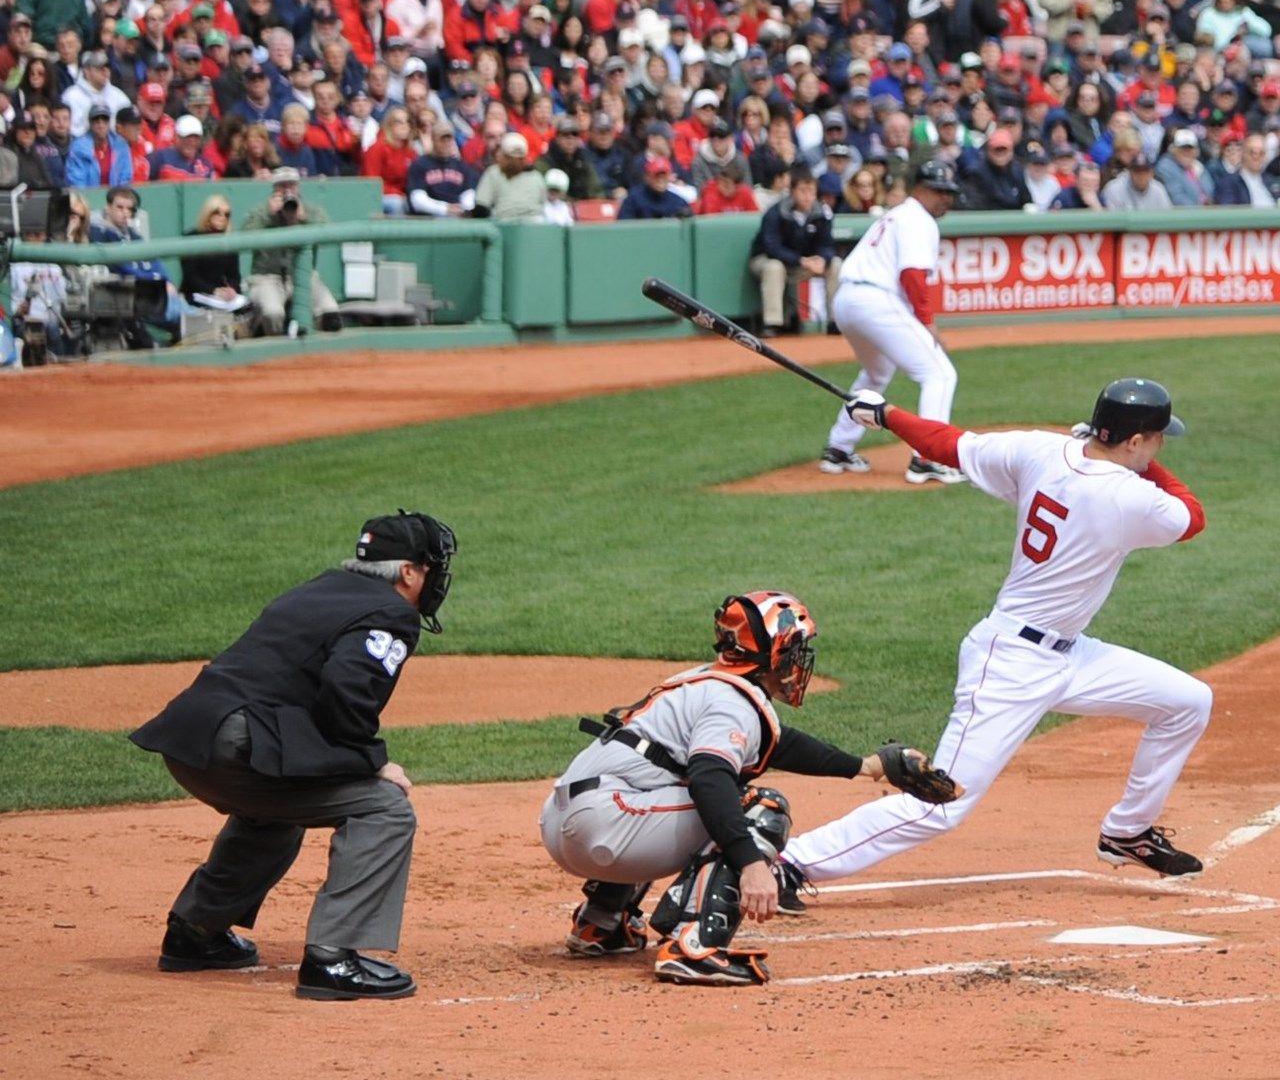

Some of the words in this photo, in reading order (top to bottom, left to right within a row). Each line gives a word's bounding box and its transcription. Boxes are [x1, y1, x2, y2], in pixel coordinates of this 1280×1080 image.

[927, 237, 1010, 286] RED
[1020, 234, 1106, 282] SOX
[1021, 490, 1069, 565] 5
[365, 629, 408, 677] 32
